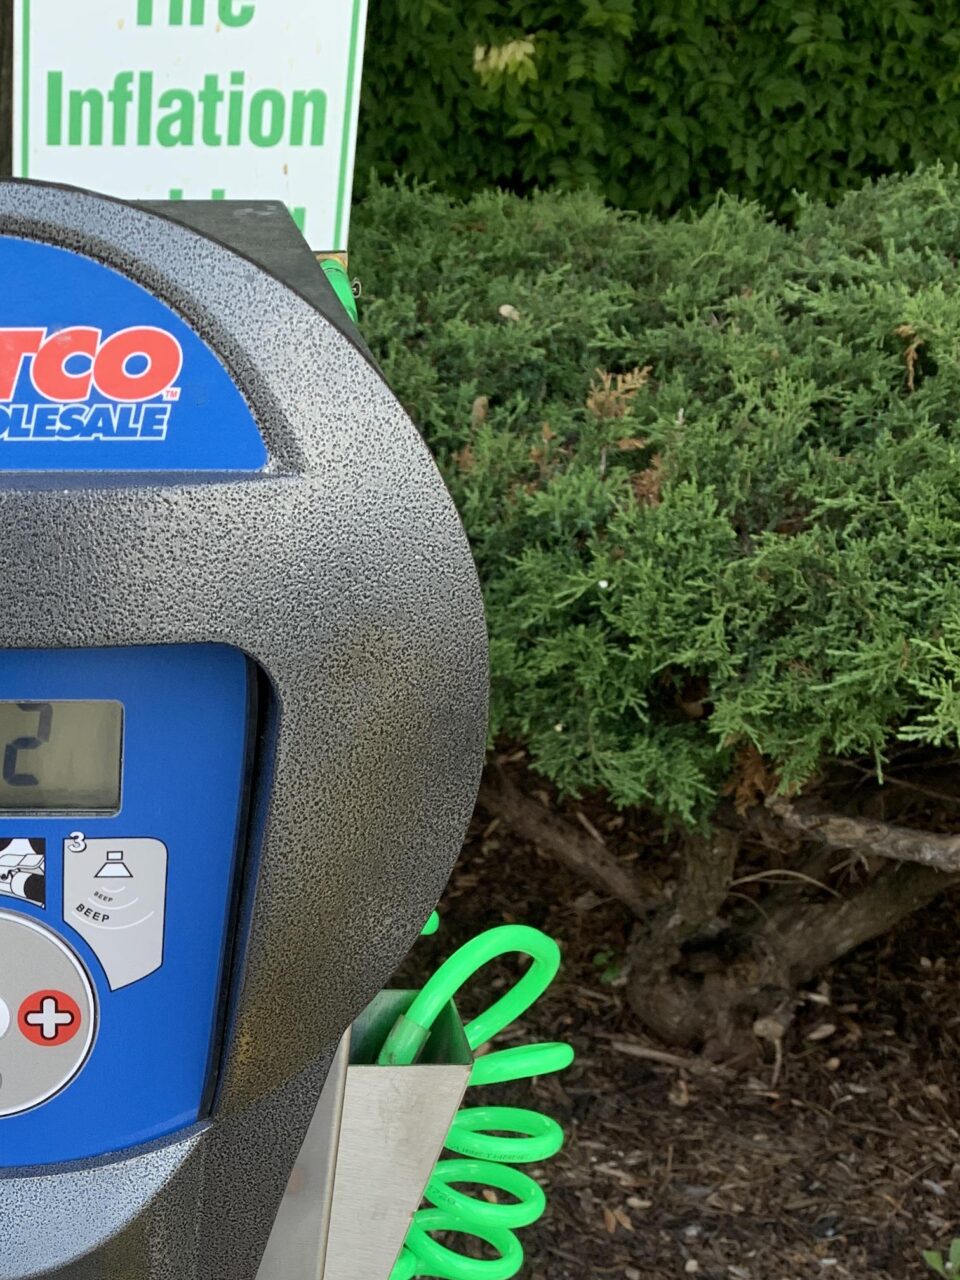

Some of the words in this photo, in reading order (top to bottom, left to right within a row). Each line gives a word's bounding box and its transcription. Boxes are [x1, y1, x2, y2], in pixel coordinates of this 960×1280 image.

[46, 70, 327, 148] Inflation
[68, 831, 87, 853] 3
[94, 891, 113, 902] BEEP
[76, 904, 109, 922] BEEP
